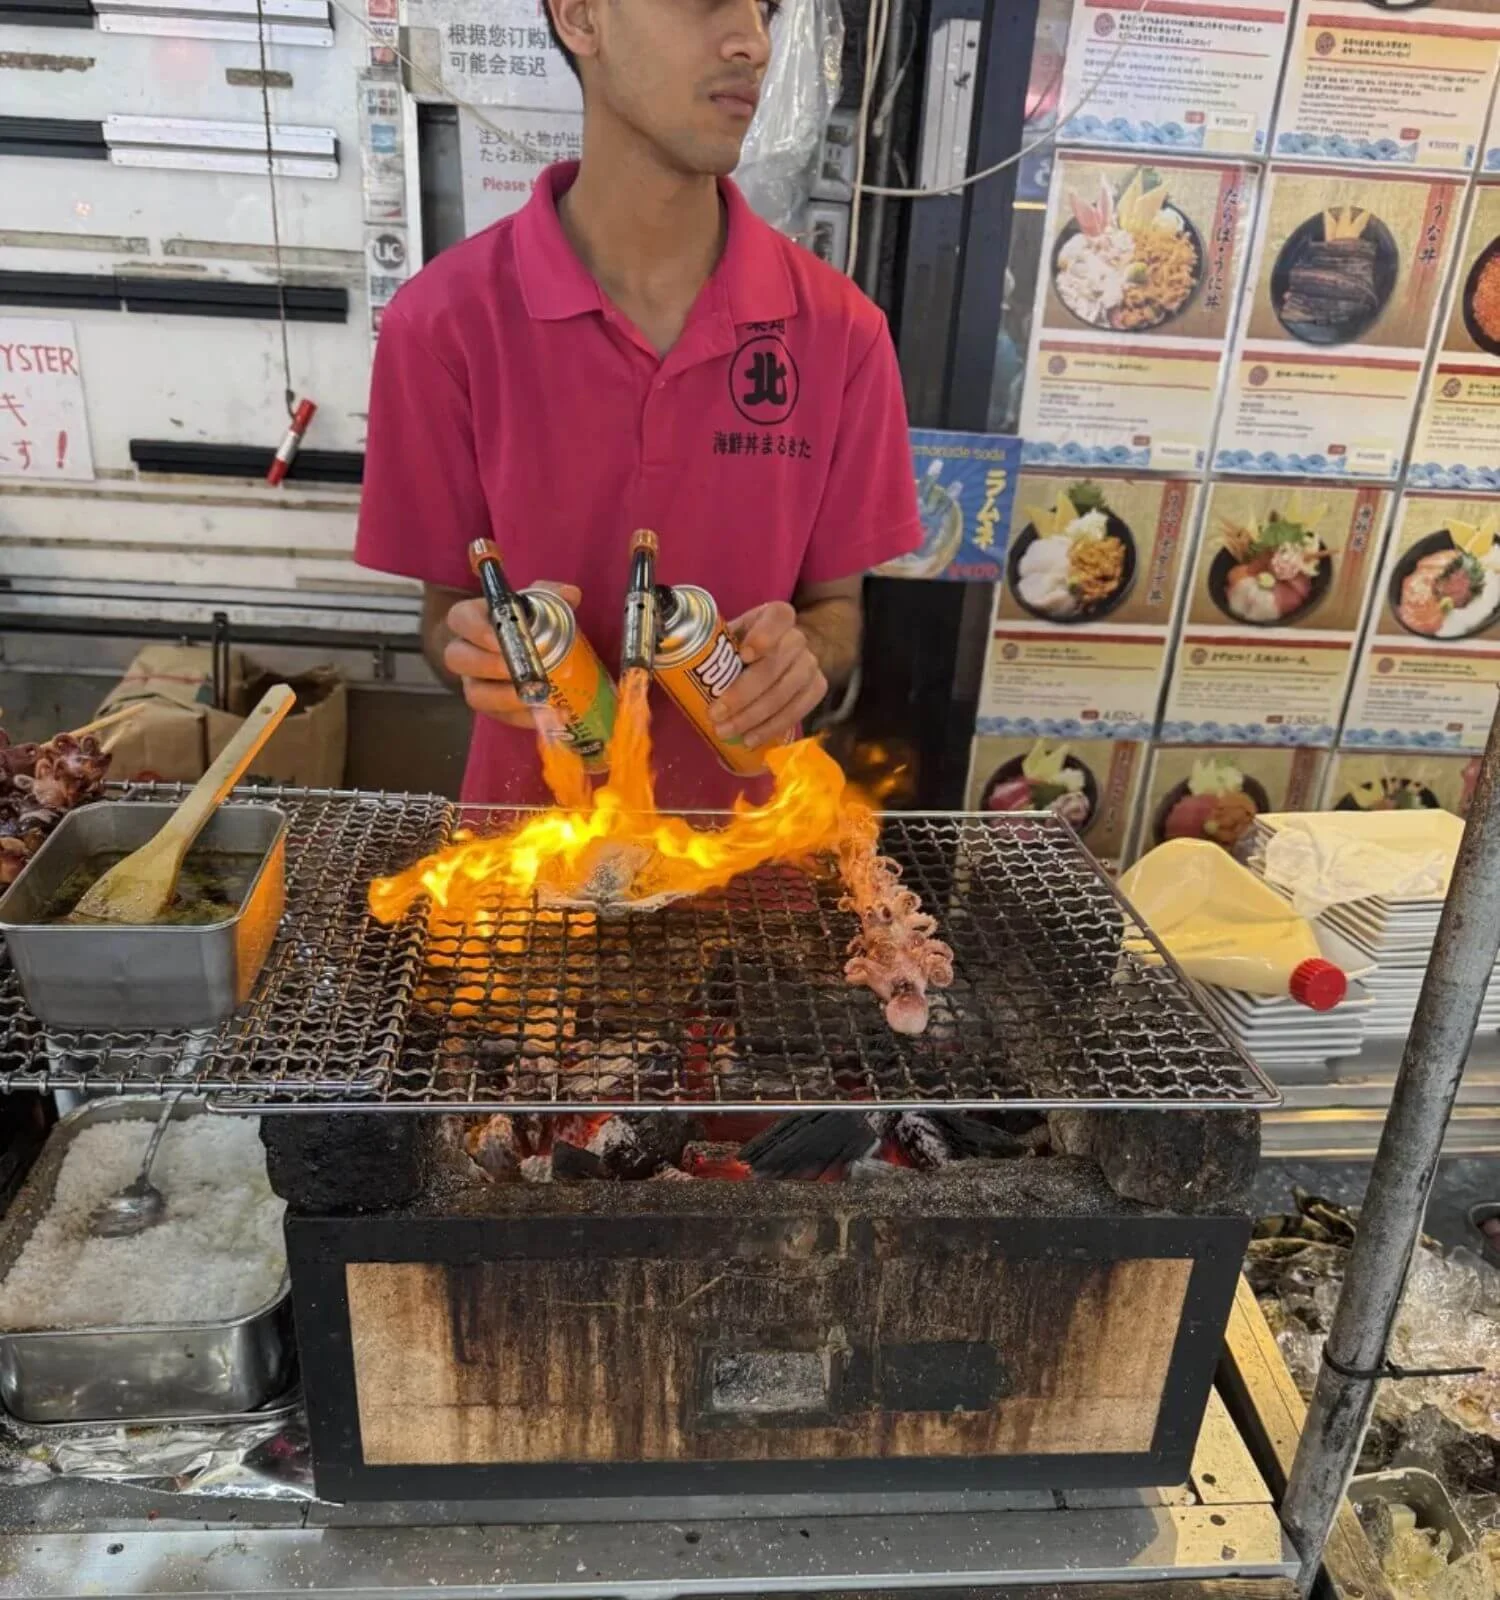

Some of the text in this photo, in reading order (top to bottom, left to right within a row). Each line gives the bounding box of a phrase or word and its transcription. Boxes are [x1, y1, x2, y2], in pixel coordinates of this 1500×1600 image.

[449, 51, 547, 77] 可能会延迟
[482, 177, 527, 193] Please
[742, 351, 788, 406] 北
[712, 430, 812, 459] 海鮮丼まるきた
